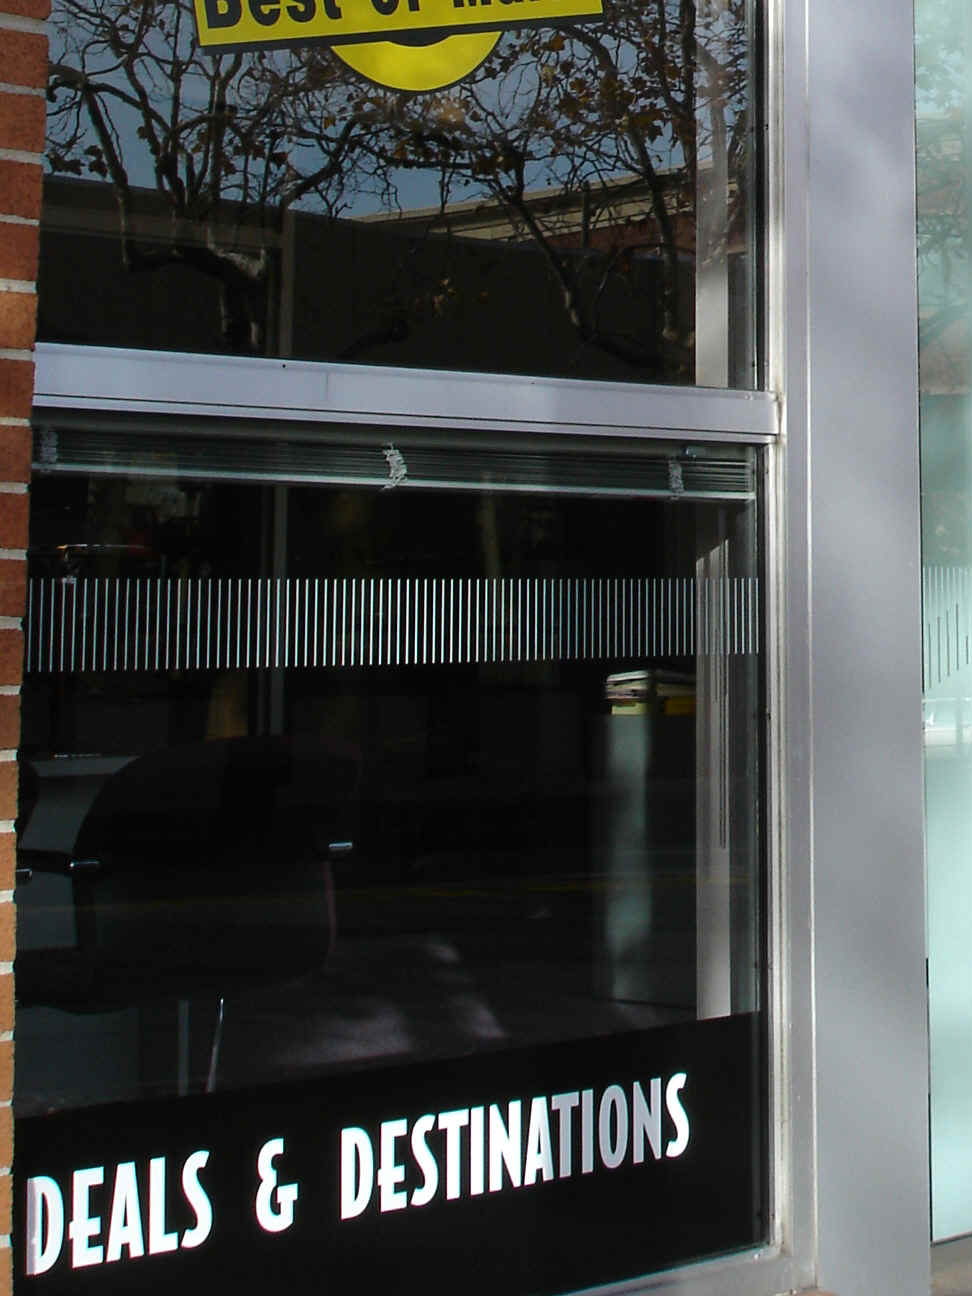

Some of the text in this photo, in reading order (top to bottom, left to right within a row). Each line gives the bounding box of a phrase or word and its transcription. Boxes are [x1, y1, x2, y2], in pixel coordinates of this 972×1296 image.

[25, 1072, 690, 1275] DEALS & DESTINATIONS
